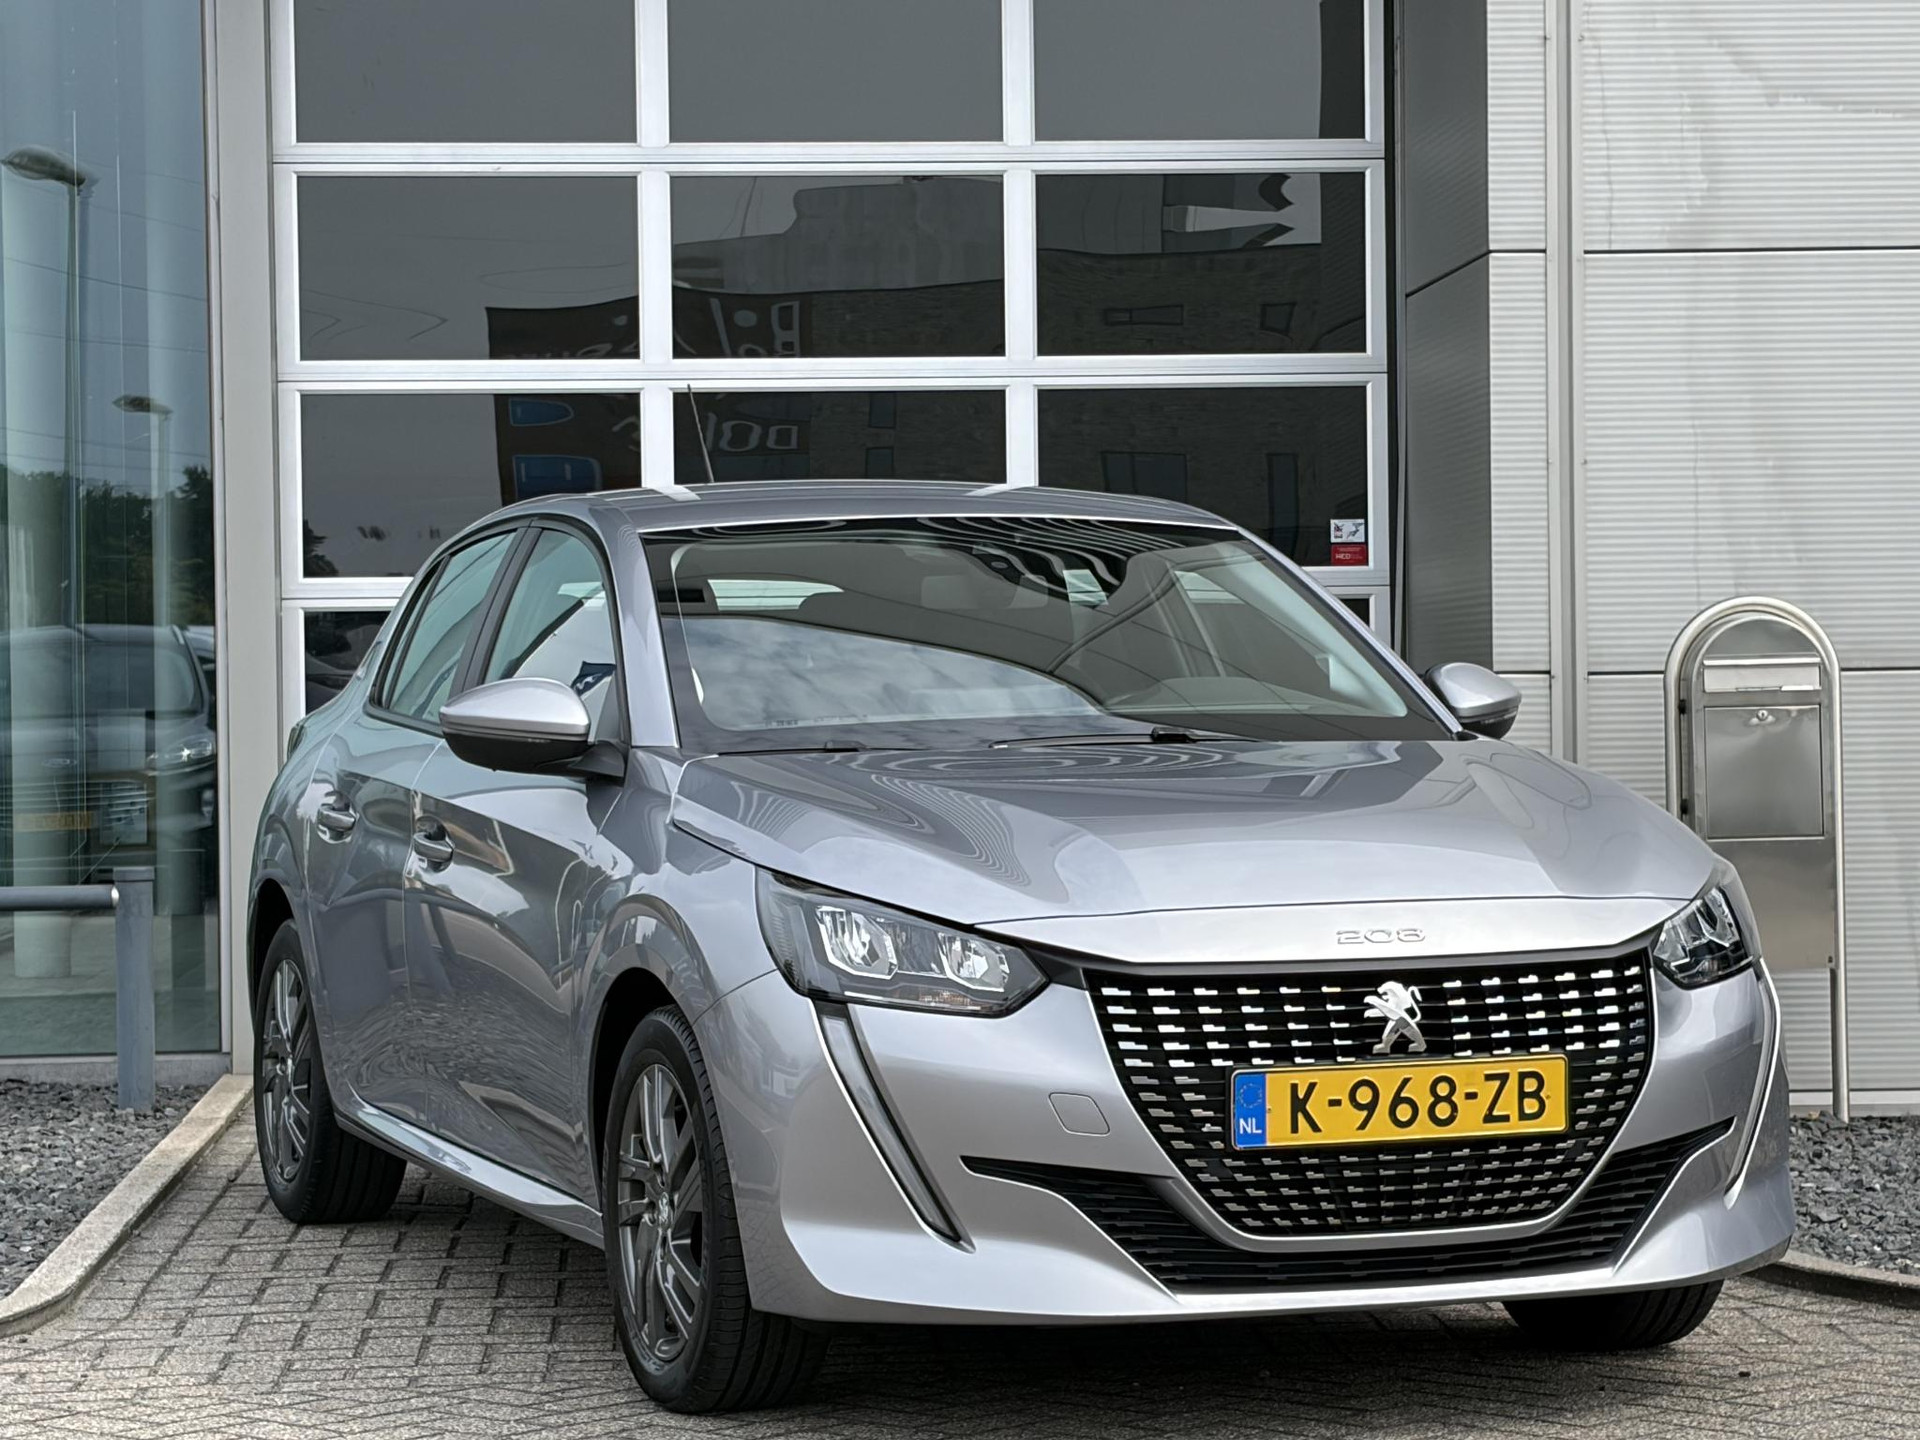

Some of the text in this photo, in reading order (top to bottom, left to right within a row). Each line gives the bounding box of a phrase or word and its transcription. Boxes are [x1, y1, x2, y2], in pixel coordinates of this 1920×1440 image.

[1336, 928, 1426, 945] 208
[1289, 1069, 1547, 1135] K-968-ZB
[1239, 1117, 1262, 1135] NL
